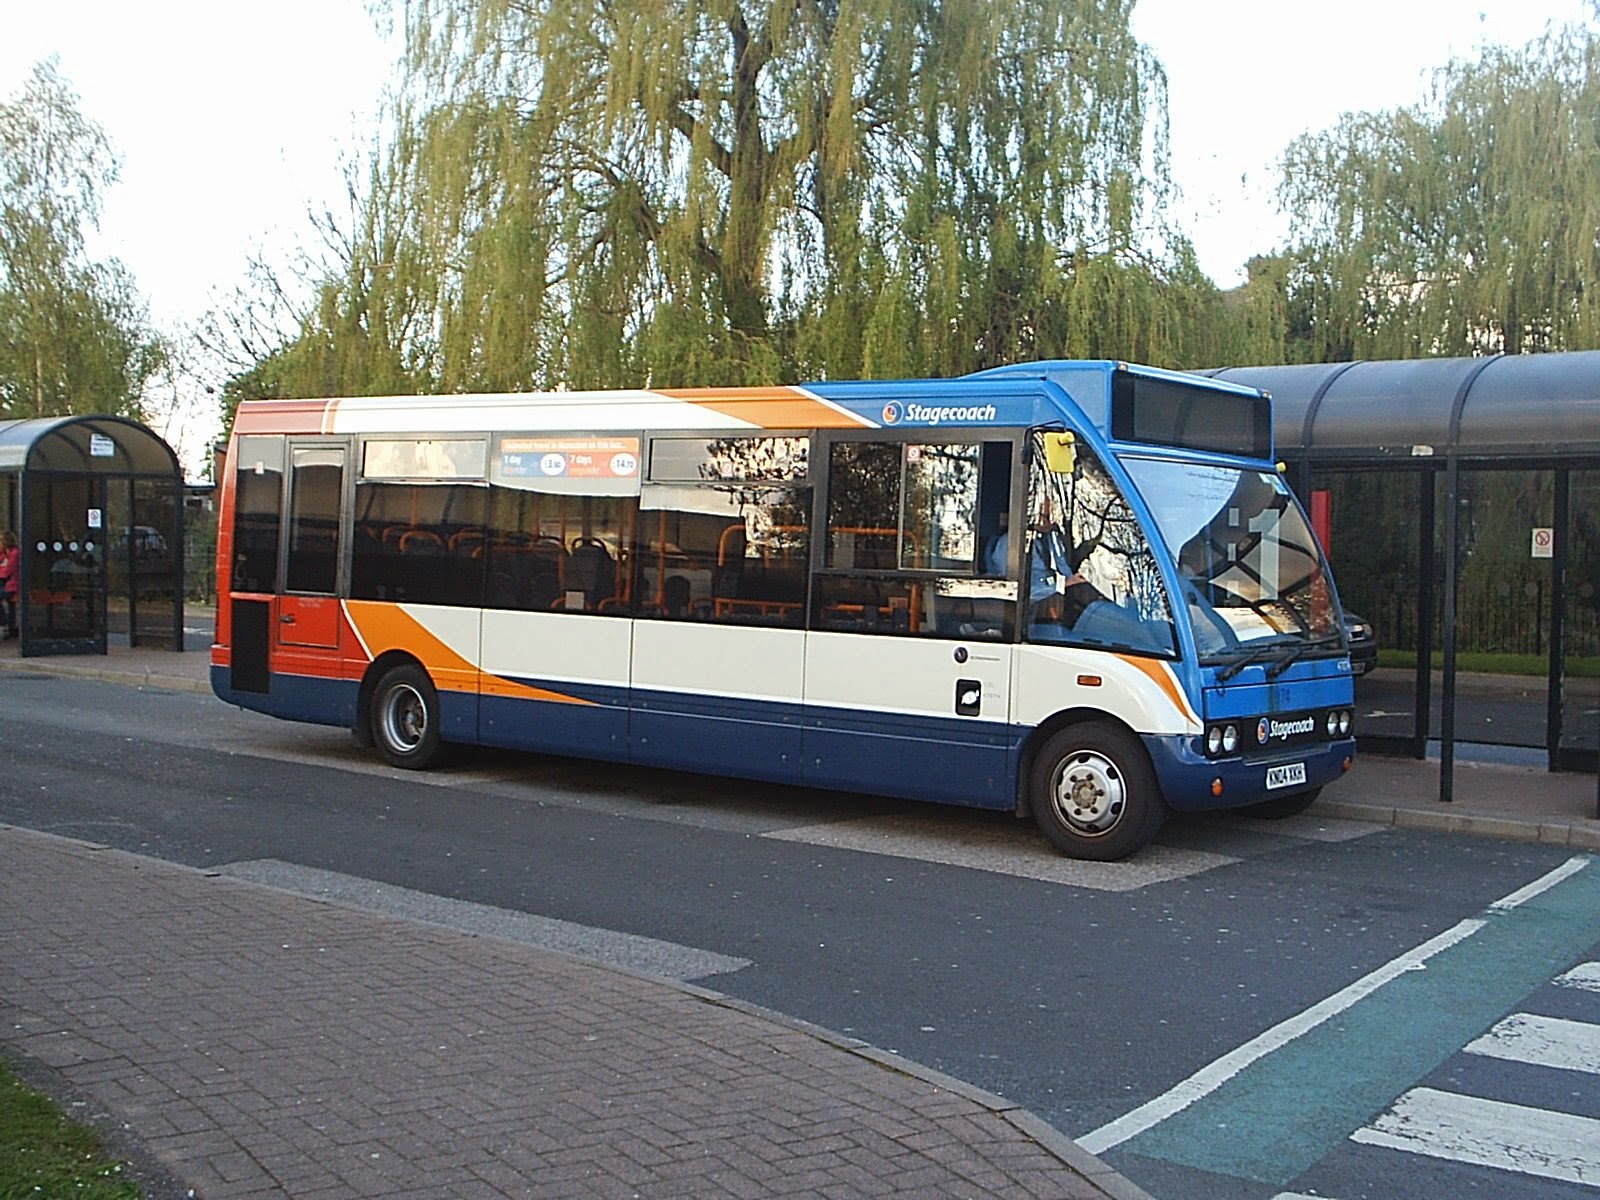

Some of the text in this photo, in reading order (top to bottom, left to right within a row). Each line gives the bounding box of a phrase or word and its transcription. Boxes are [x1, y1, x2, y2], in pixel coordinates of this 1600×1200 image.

[905, 403, 996, 426] Stagecoach
[509, 454, 522, 466] day
[569, 454, 592, 466] 7 days
[1269, 716, 1315, 741] Stagecoach
